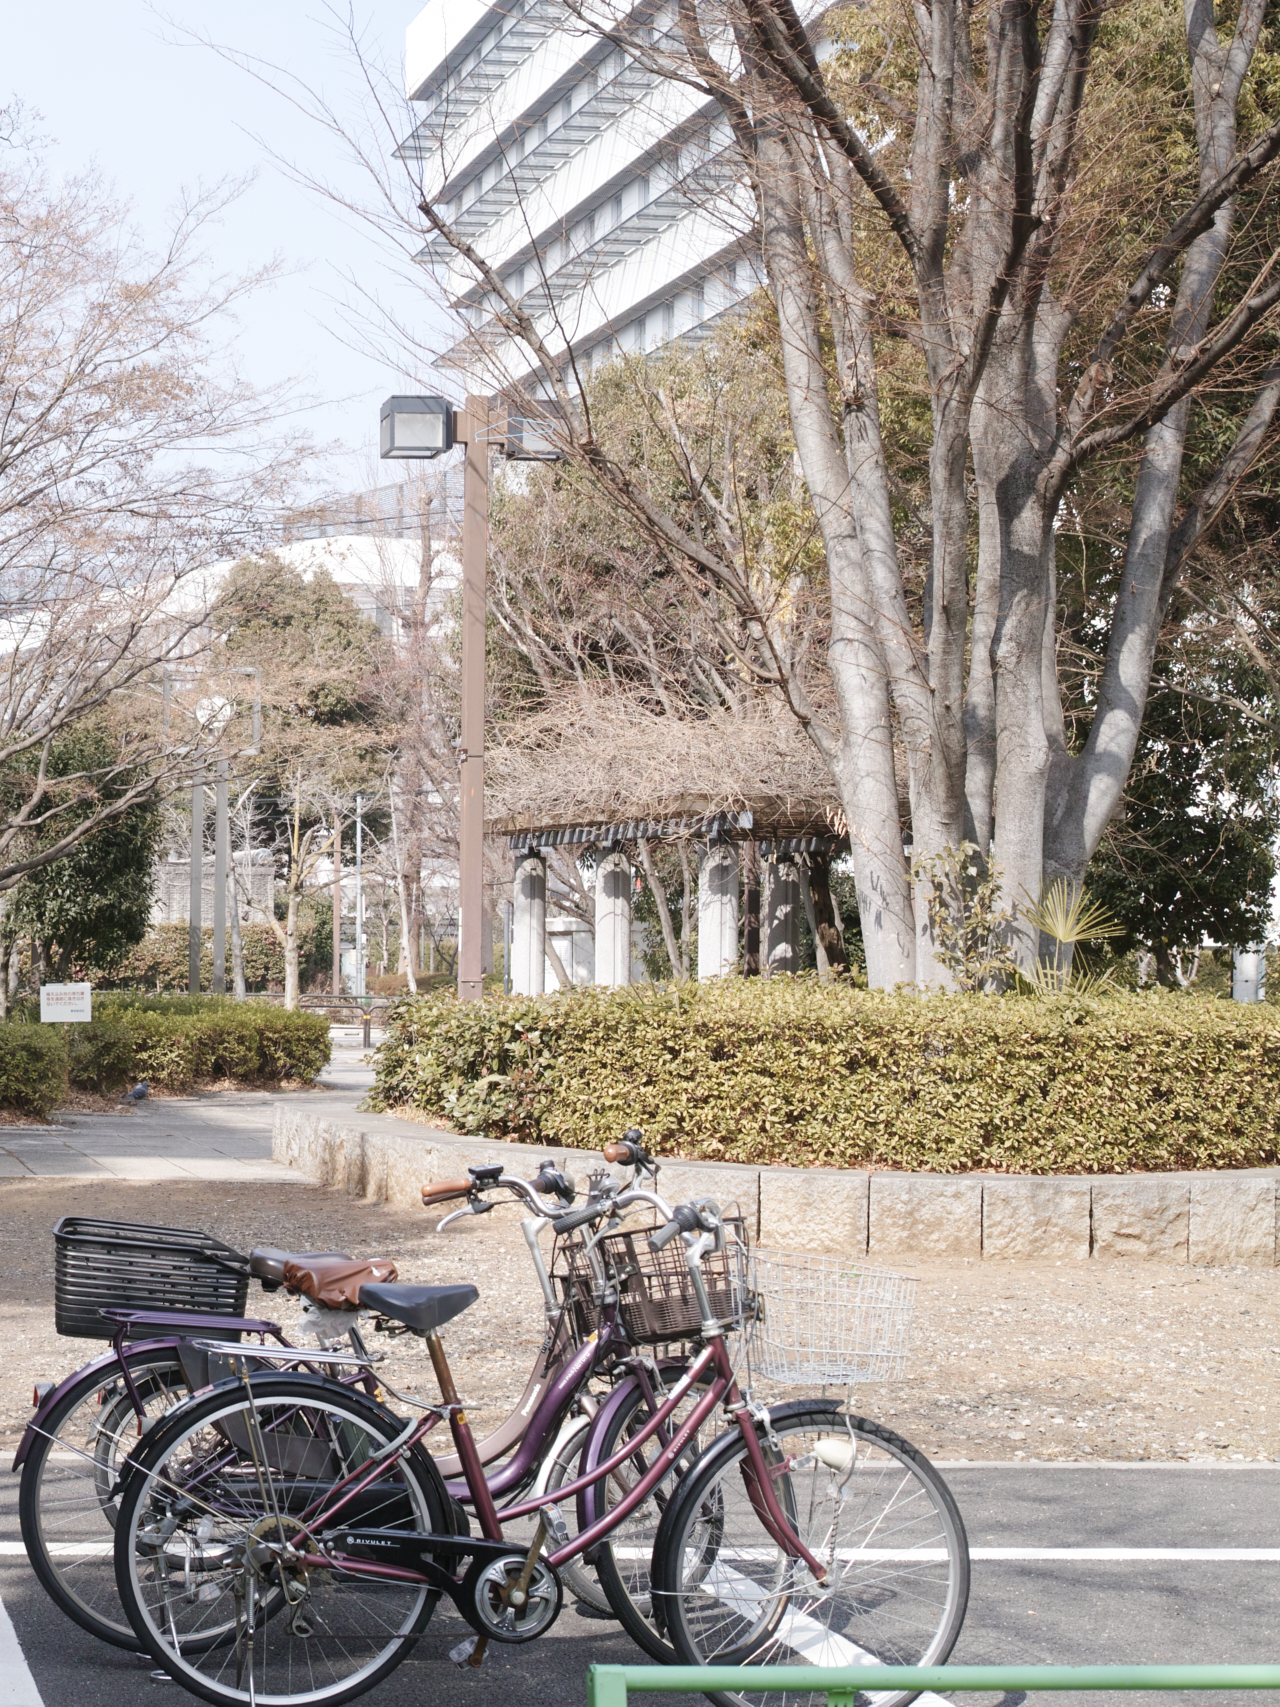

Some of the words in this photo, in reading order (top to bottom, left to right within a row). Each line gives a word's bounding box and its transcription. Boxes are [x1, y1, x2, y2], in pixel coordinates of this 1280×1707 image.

[521, 1383, 541, 1416] Panasonic
[673, 1429, 690, 1452] RIVULET
[356, 1538, 392, 1546] RIVULET
